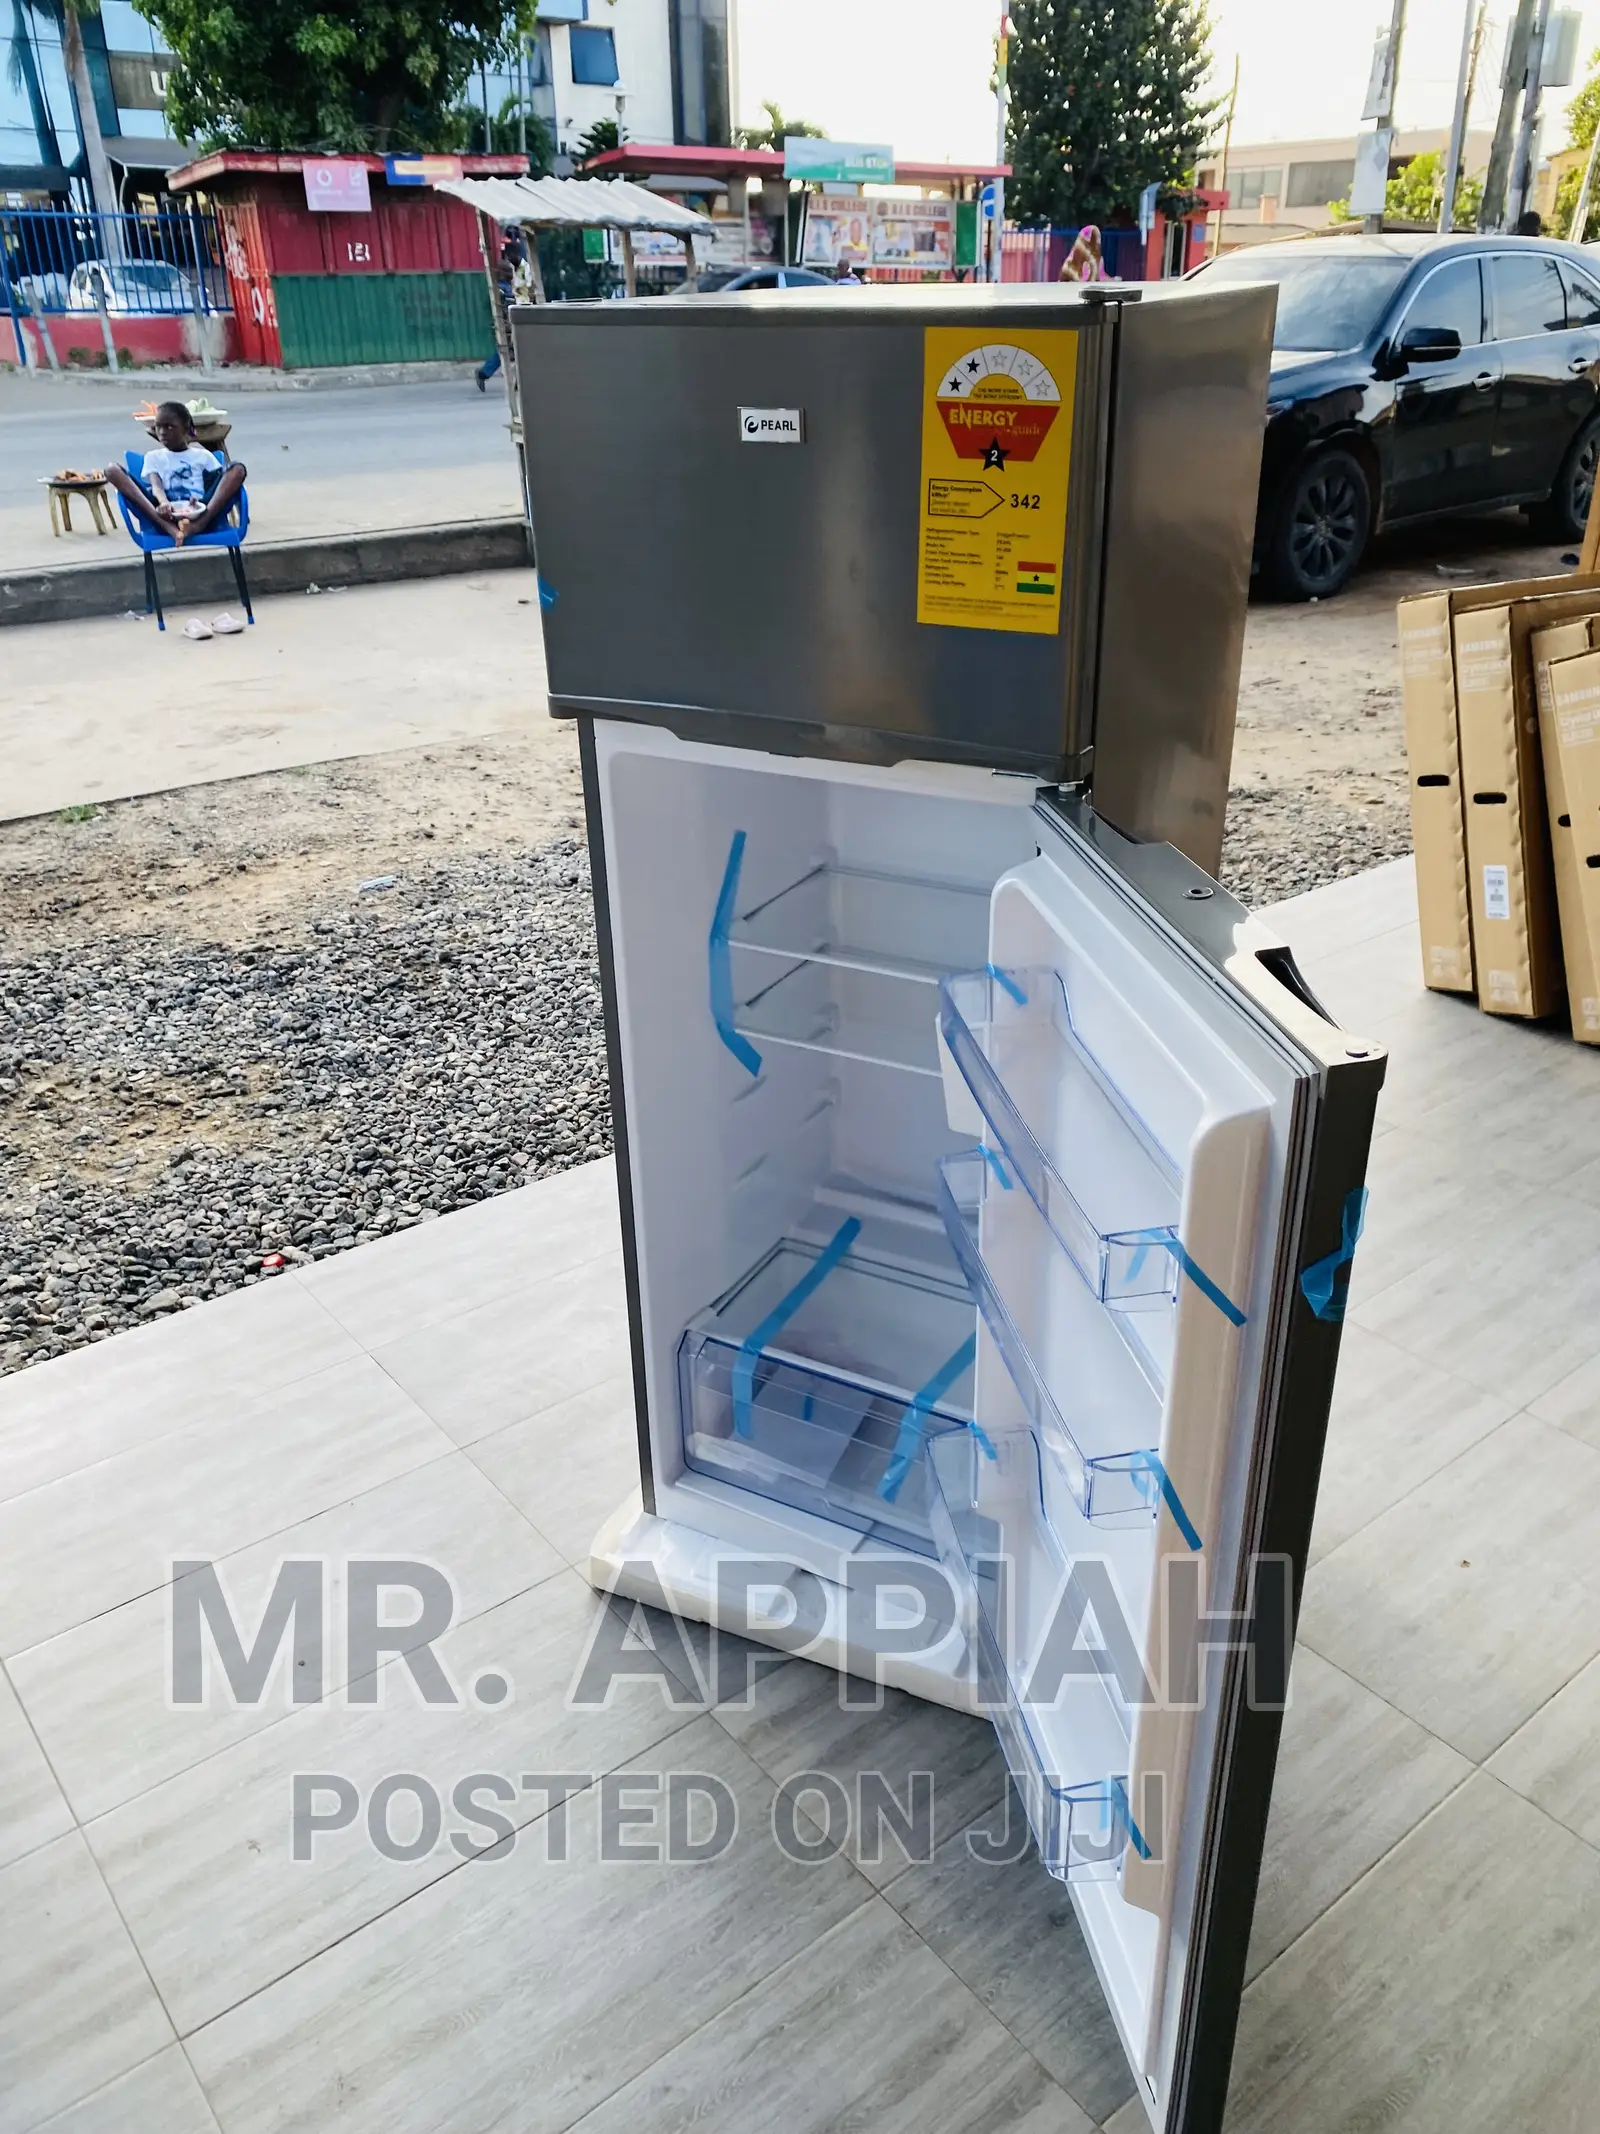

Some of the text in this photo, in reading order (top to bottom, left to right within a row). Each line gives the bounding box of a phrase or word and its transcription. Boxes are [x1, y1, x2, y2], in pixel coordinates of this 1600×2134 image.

[950, 404, 1018, 430] ENERGY
[761, 419, 797, 431] PEARL
[990, 450, 998, 462] 2
[1010, 493, 1041, 510] 342
